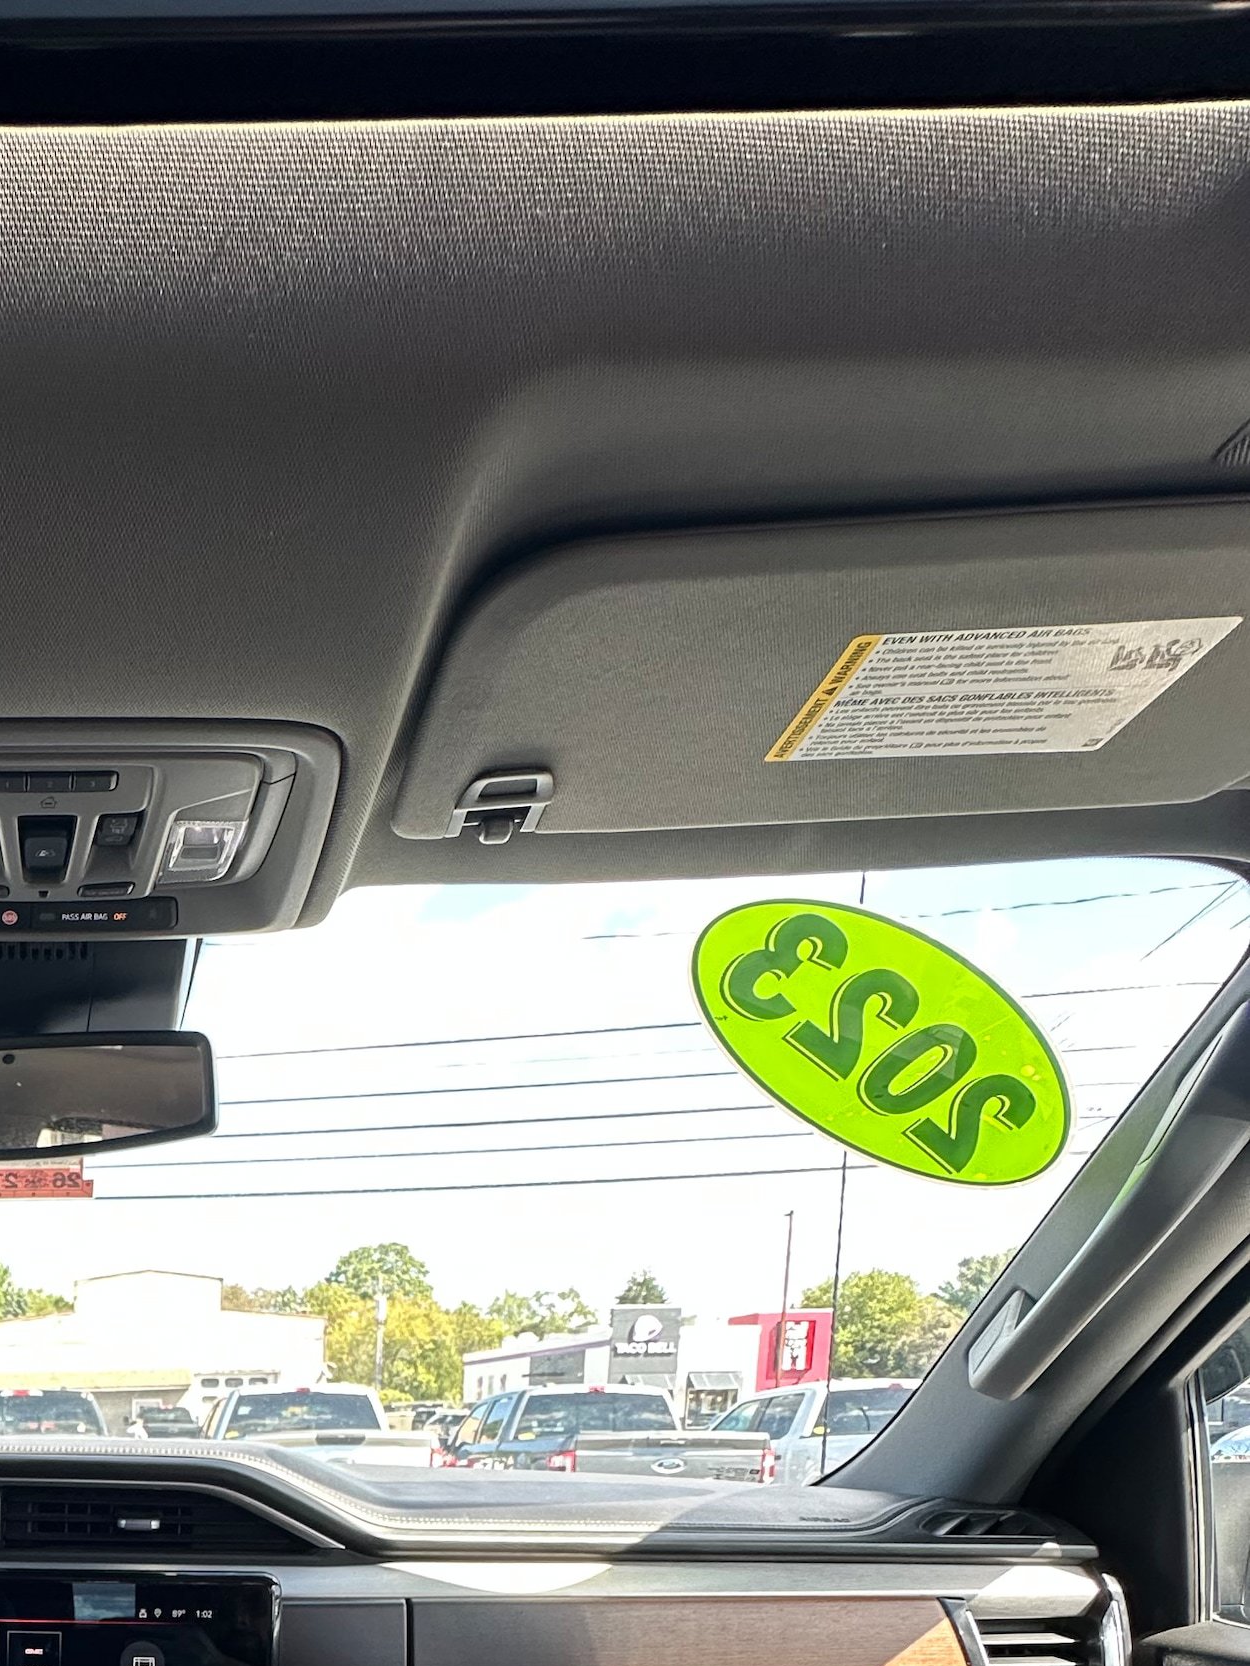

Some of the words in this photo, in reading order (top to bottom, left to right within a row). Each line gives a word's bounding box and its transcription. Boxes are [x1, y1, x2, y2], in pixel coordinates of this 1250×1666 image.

[882, 636, 917, 645] EVEN
[920, 634, 954, 643] WITH
[954, 631, 1027, 641] ADVANCED
[1028, 630, 1051, 638] AIR
[1053, 628, 1092, 637] BAGS
[828, 641, 872, 685] WARNING
[869, 697, 901, 705] AVEC
[902, 696, 926, 704] DES
[926, 694, 958, 703] SACS
[959, 691, 1033, 702] GONFLABLES
[1033, 689, 1117, 699] INTELLIGENTS
[773, 698, 829, 758] AVERTISSEMENT
[61, 913, 80, 921] PASS
[80, 912, 93, 921] AIR
[93, 912, 108, 921] BAG
[113, 912, 128, 921] OFF
[614, 1342, 647, 1355] TACO
[196, 1610, 213, 1619] 1:02
